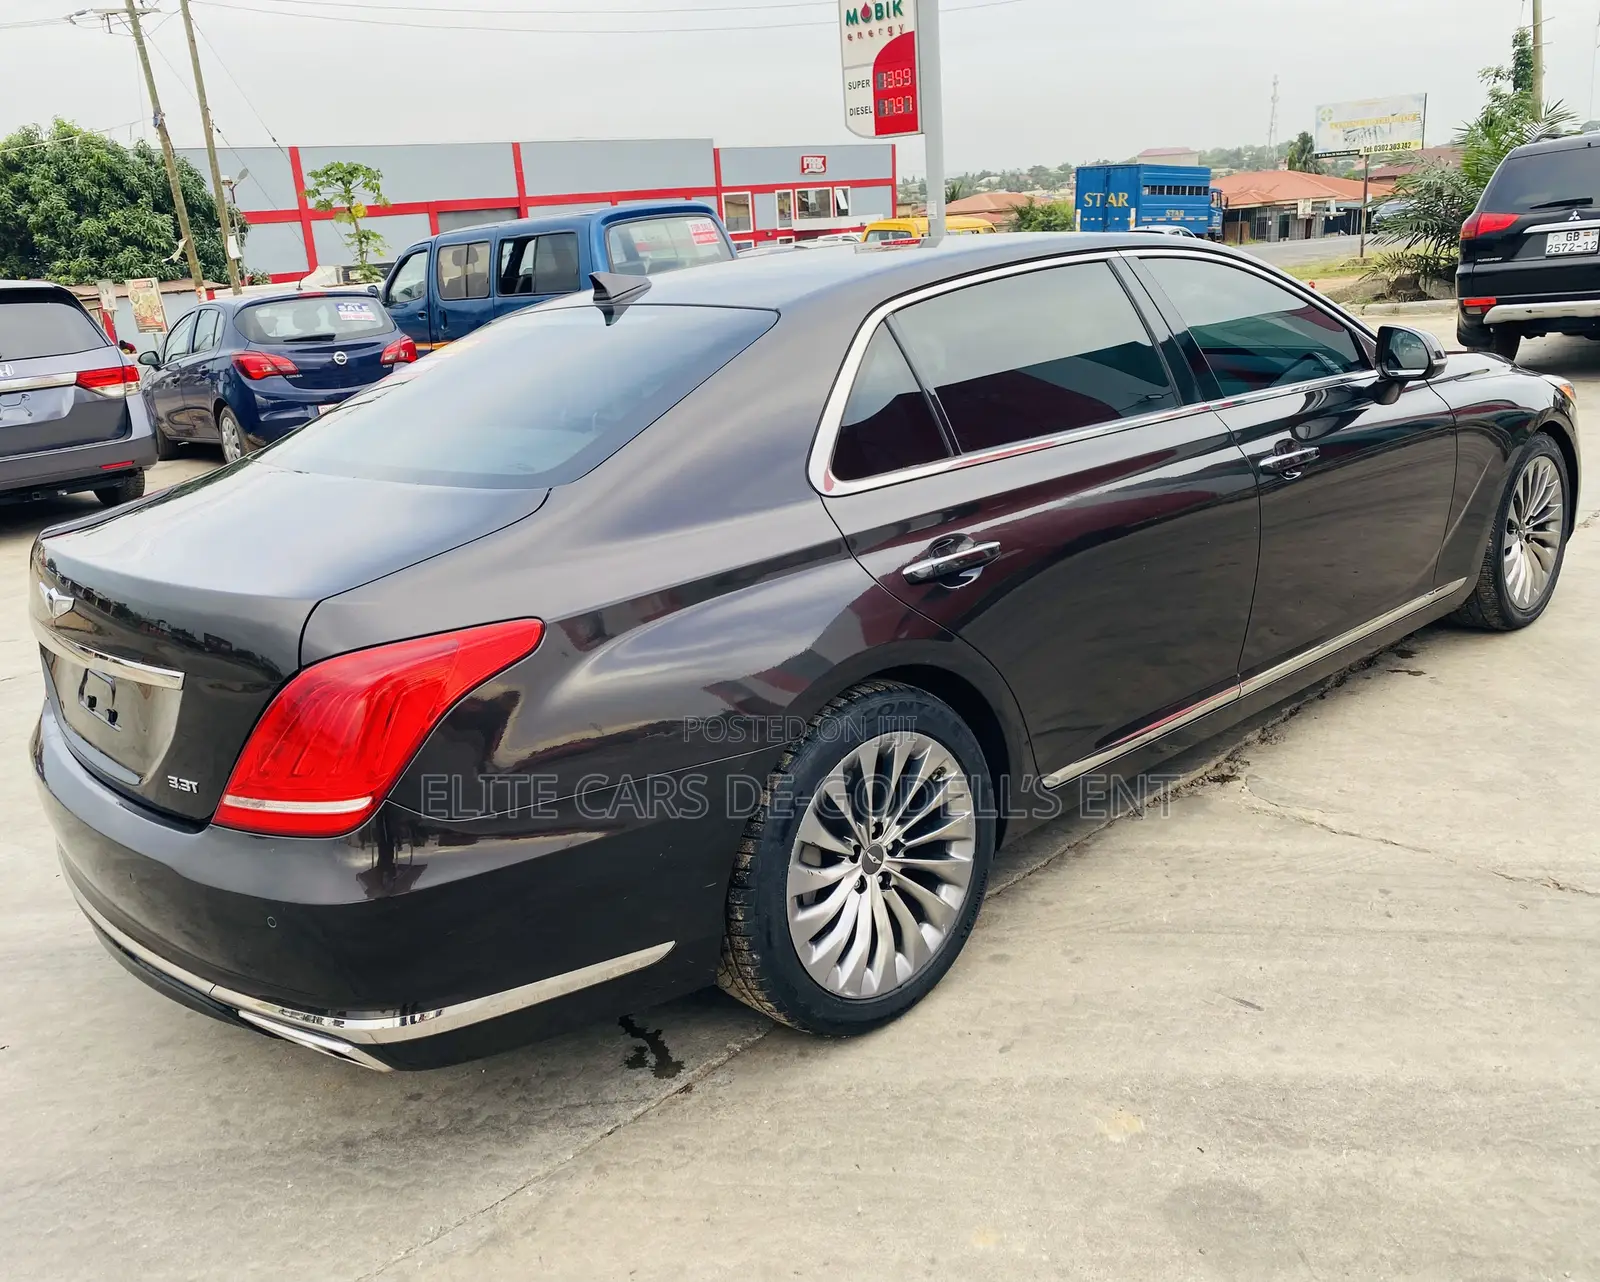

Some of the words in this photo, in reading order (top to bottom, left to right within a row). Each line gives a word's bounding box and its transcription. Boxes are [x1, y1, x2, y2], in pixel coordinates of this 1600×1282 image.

[845, 0, 903, 26] MOBIK
[847, 24, 904, 41] energy
[848, 79, 870, 90] SUPER
[849, 106, 873, 116] DIESEL
[1084, 192, 1129, 207] STAR
[1566, 232, 1580, 242] GB
[1547, 241, 1597, 253] 2572-12
